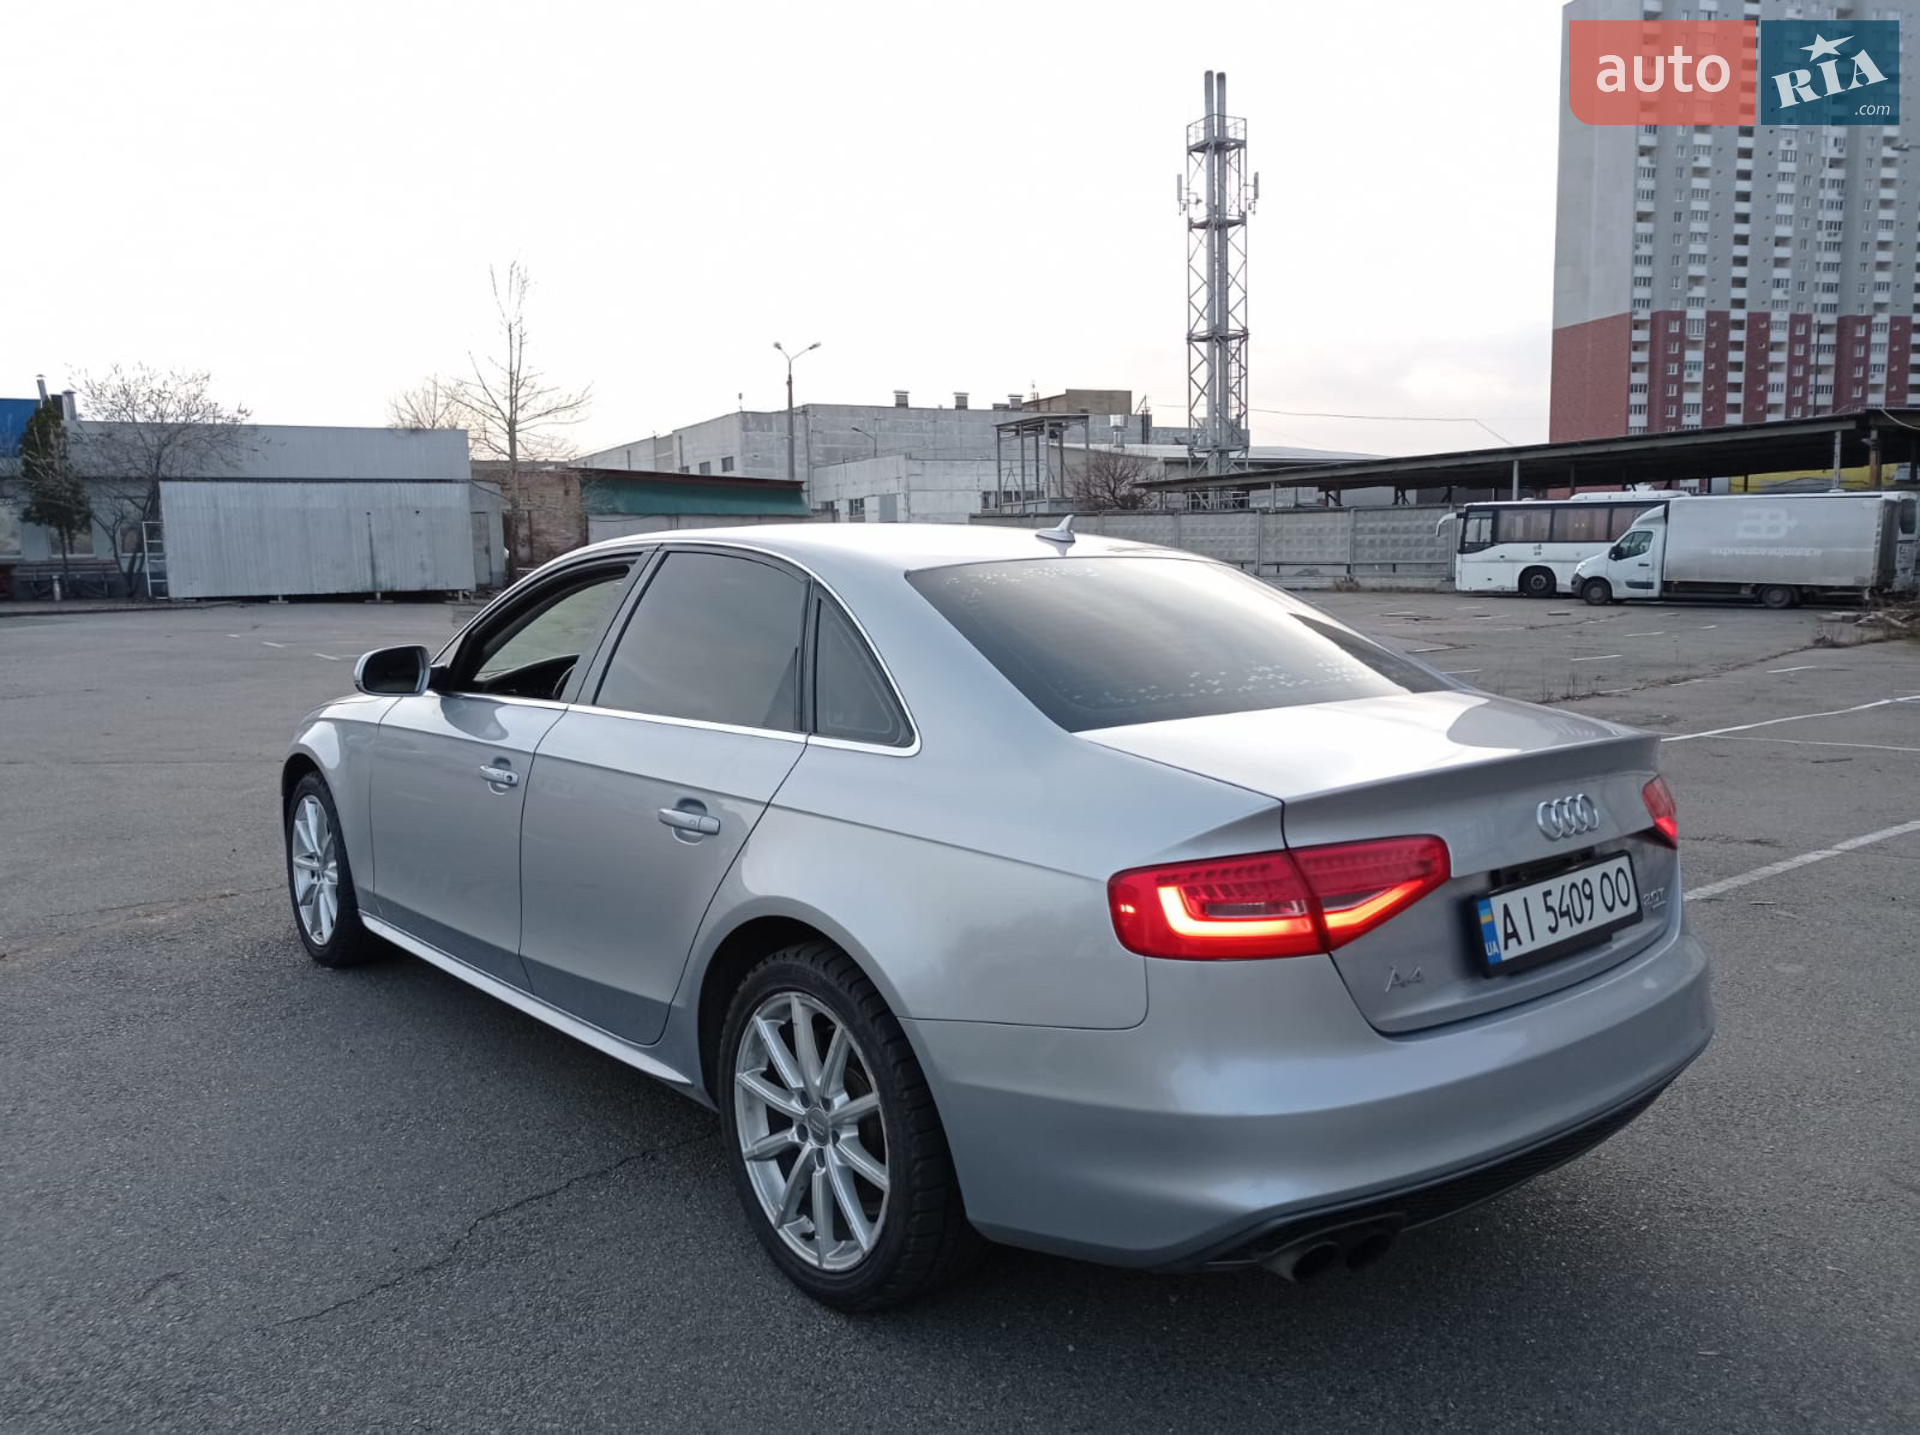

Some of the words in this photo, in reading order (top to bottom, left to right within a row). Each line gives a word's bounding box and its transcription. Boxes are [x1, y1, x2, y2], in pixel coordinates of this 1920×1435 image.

[1503, 896, 1535, 950] AI
[1542, 877, 1595, 934] 5409
[1600, 867, 1631, 913] OO
[1485, 940, 1500, 956] UA
[1385, 965, 1422, 992] A4
